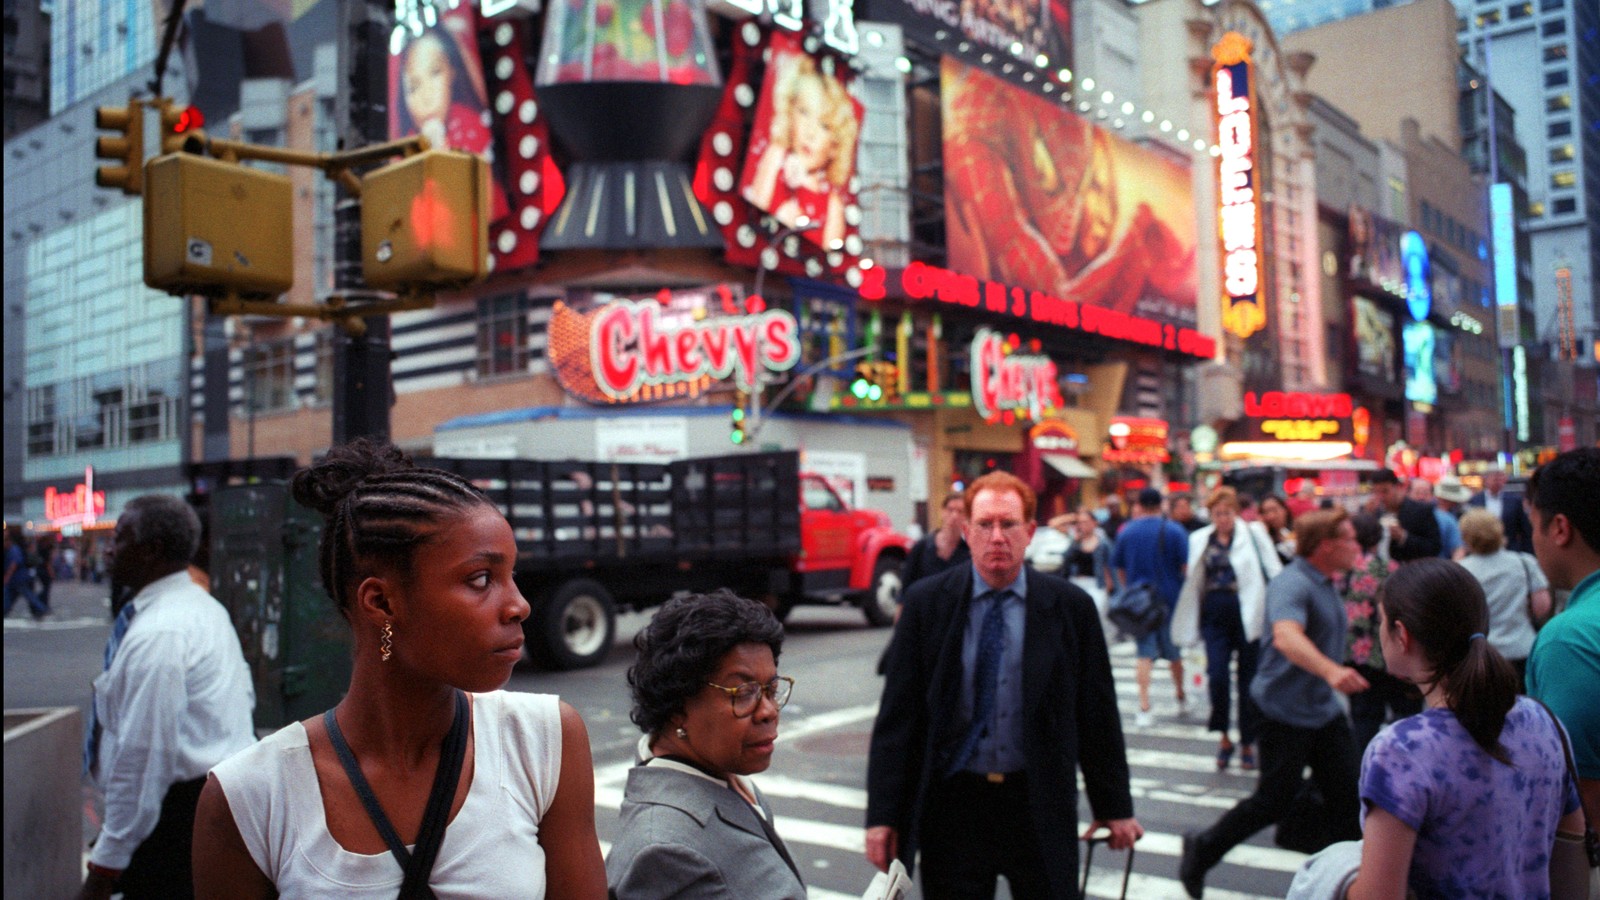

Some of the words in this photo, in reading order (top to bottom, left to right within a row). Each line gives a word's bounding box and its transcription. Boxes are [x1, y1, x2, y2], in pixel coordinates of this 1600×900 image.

[1217, 68, 1257, 296] LOEWS
[902, 260, 980, 307] OPENS
[595, 301, 797, 395] Chevys
[1243, 390, 1353, 418] LOEWS
